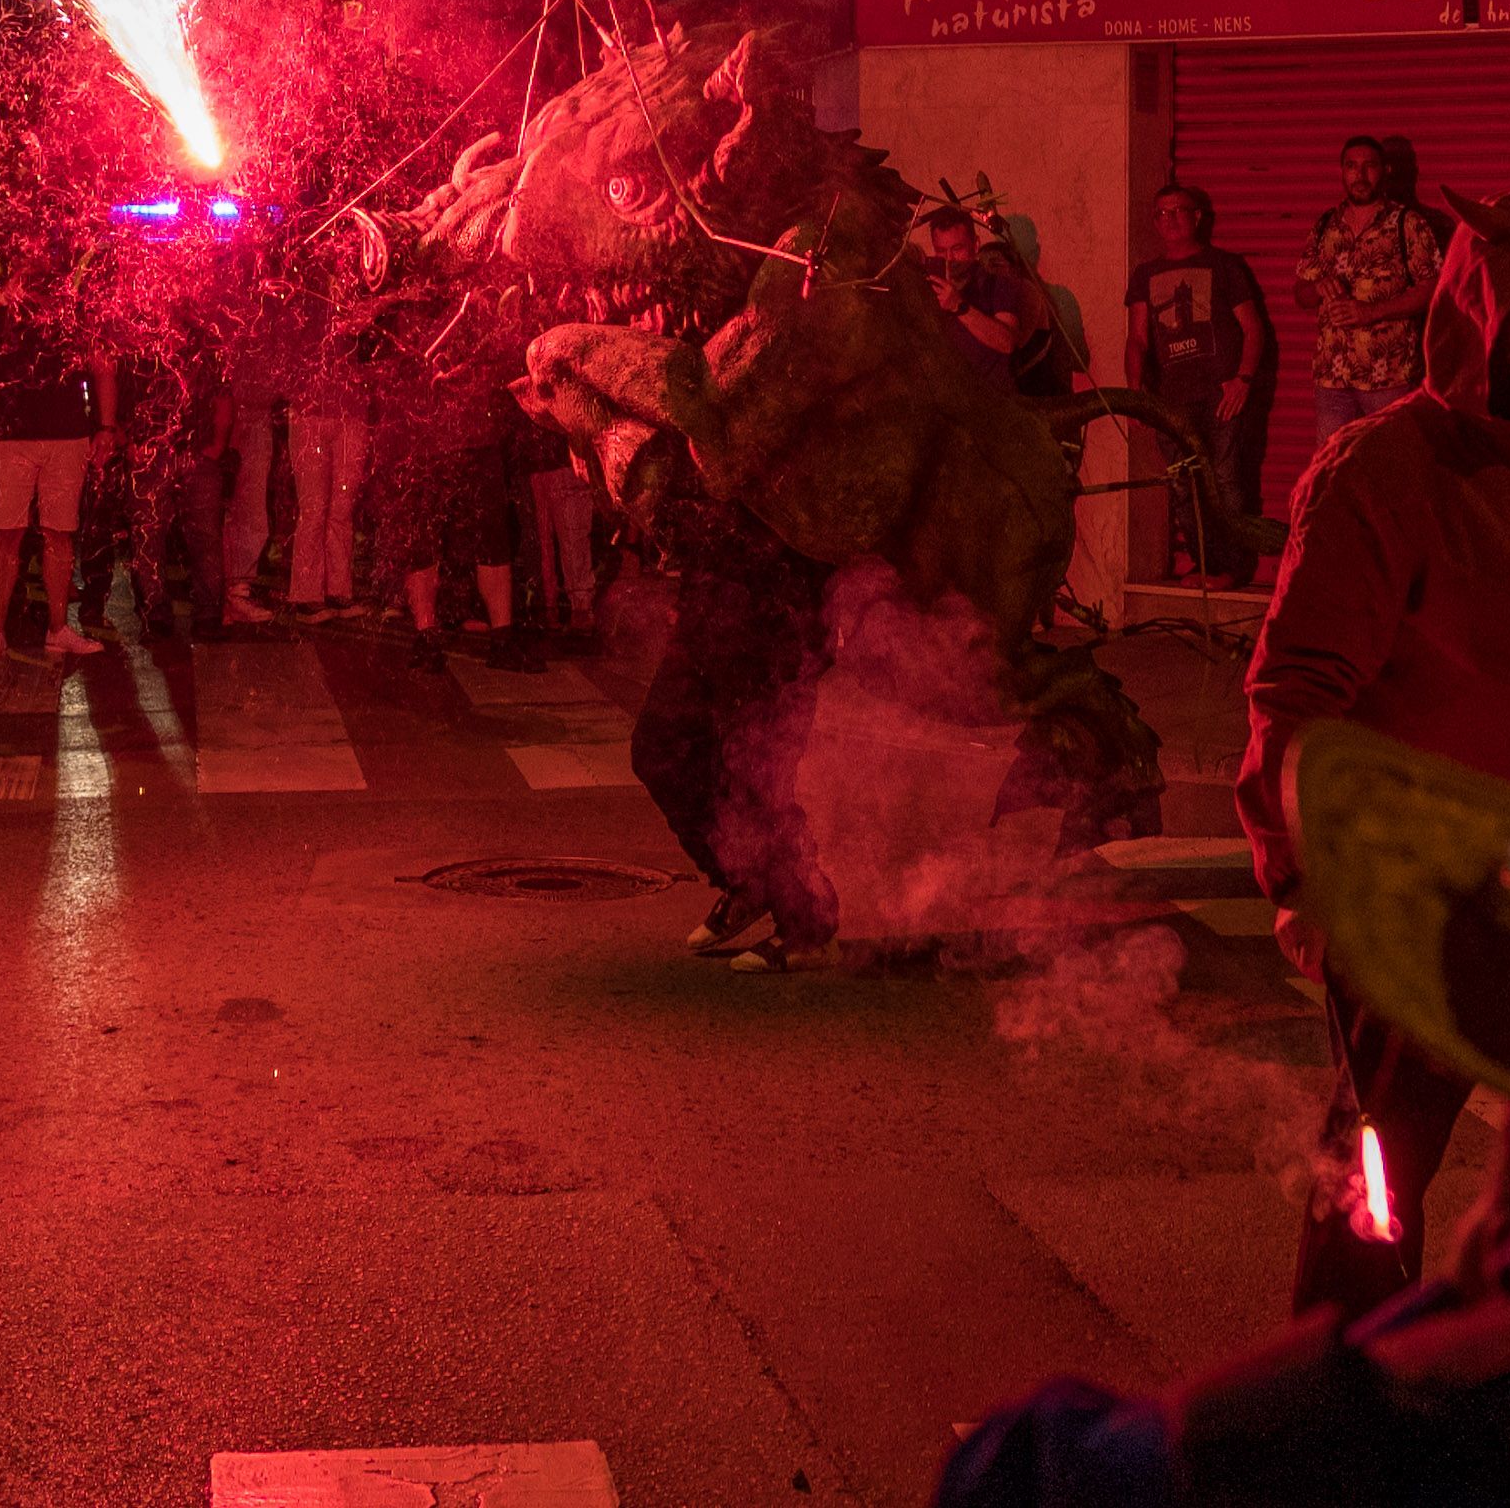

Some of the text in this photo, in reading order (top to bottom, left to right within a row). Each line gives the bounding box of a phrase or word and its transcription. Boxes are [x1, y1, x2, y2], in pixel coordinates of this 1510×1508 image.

[1438, 1, 1461, 25] de
[1104, 19, 1143, 37] DONA
[1158, 18, 1198, 34] HOME
[1213, 16, 1252, 33] NENS
[1168, 338, 1197, 353] TOKYO
